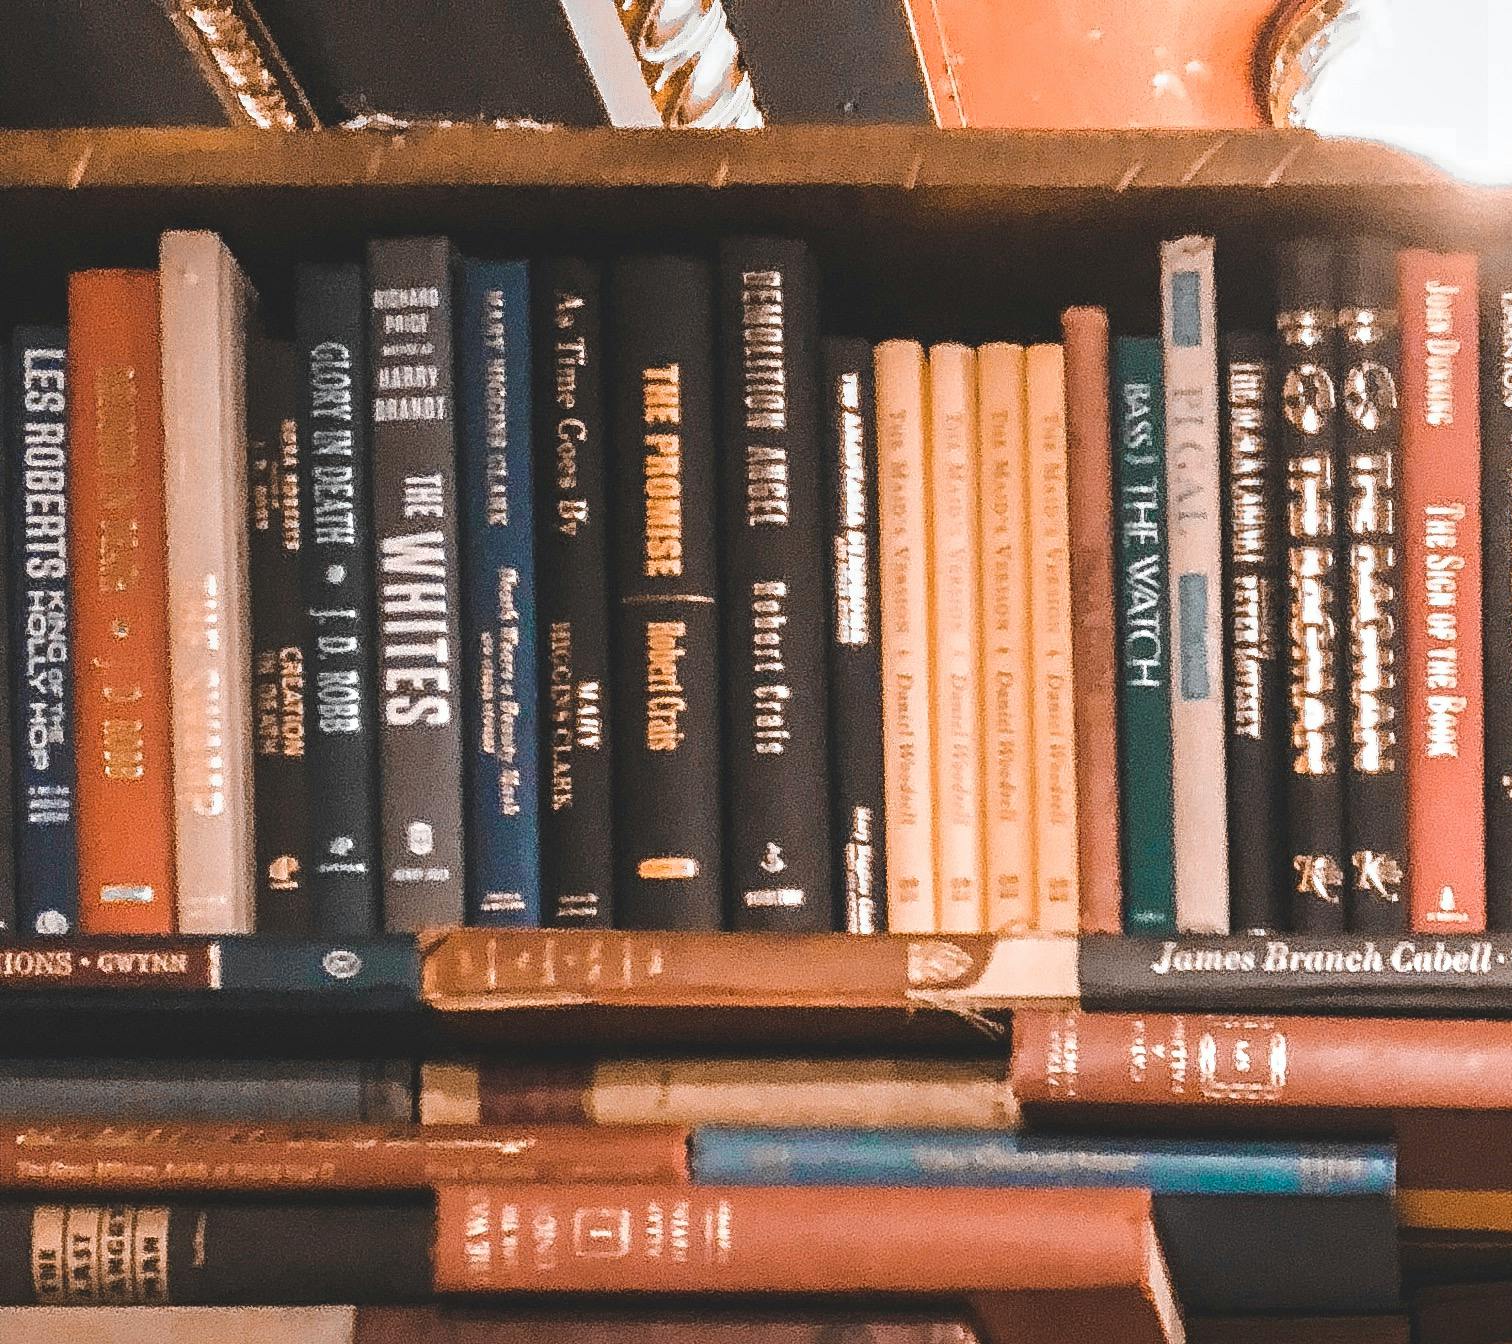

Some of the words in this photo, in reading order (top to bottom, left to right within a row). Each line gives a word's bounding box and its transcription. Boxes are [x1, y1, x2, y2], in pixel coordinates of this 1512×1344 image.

[23, 349, 66, 411] LES
[308, 342, 354, 421] GLORY
[643, 363, 680, 423] THE
[312, 429, 353, 455] IN
[25, 422, 68, 578] ROBERTS
[312, 464, 355, 544] DEATH
[403, 473, 444, 518] THE
[644, 434, 683, 577] PROMISE
[1122, 477, 1159, 546] THE
[27, 591, 48, 695] HOLLY
[380, 530, 450, 726] WHITES
[646, 621, 686, 693] Robert
[754, 582, 788, 672] Robert
[1124, 555, 1162, 688] WATCH
[28, 703, 50, 770] HOP
[279, 648, 305, 756] CREATION
[646, 696, 688, 751] Crais
[754, 684, 792, 754] Crais
[96, 951, 188, 974] GWYNN
[1150, 942, 1255, 976] James
[1263, 941, 1386, 974] Branch
[1390, 940, 1494, 974] Cabell
